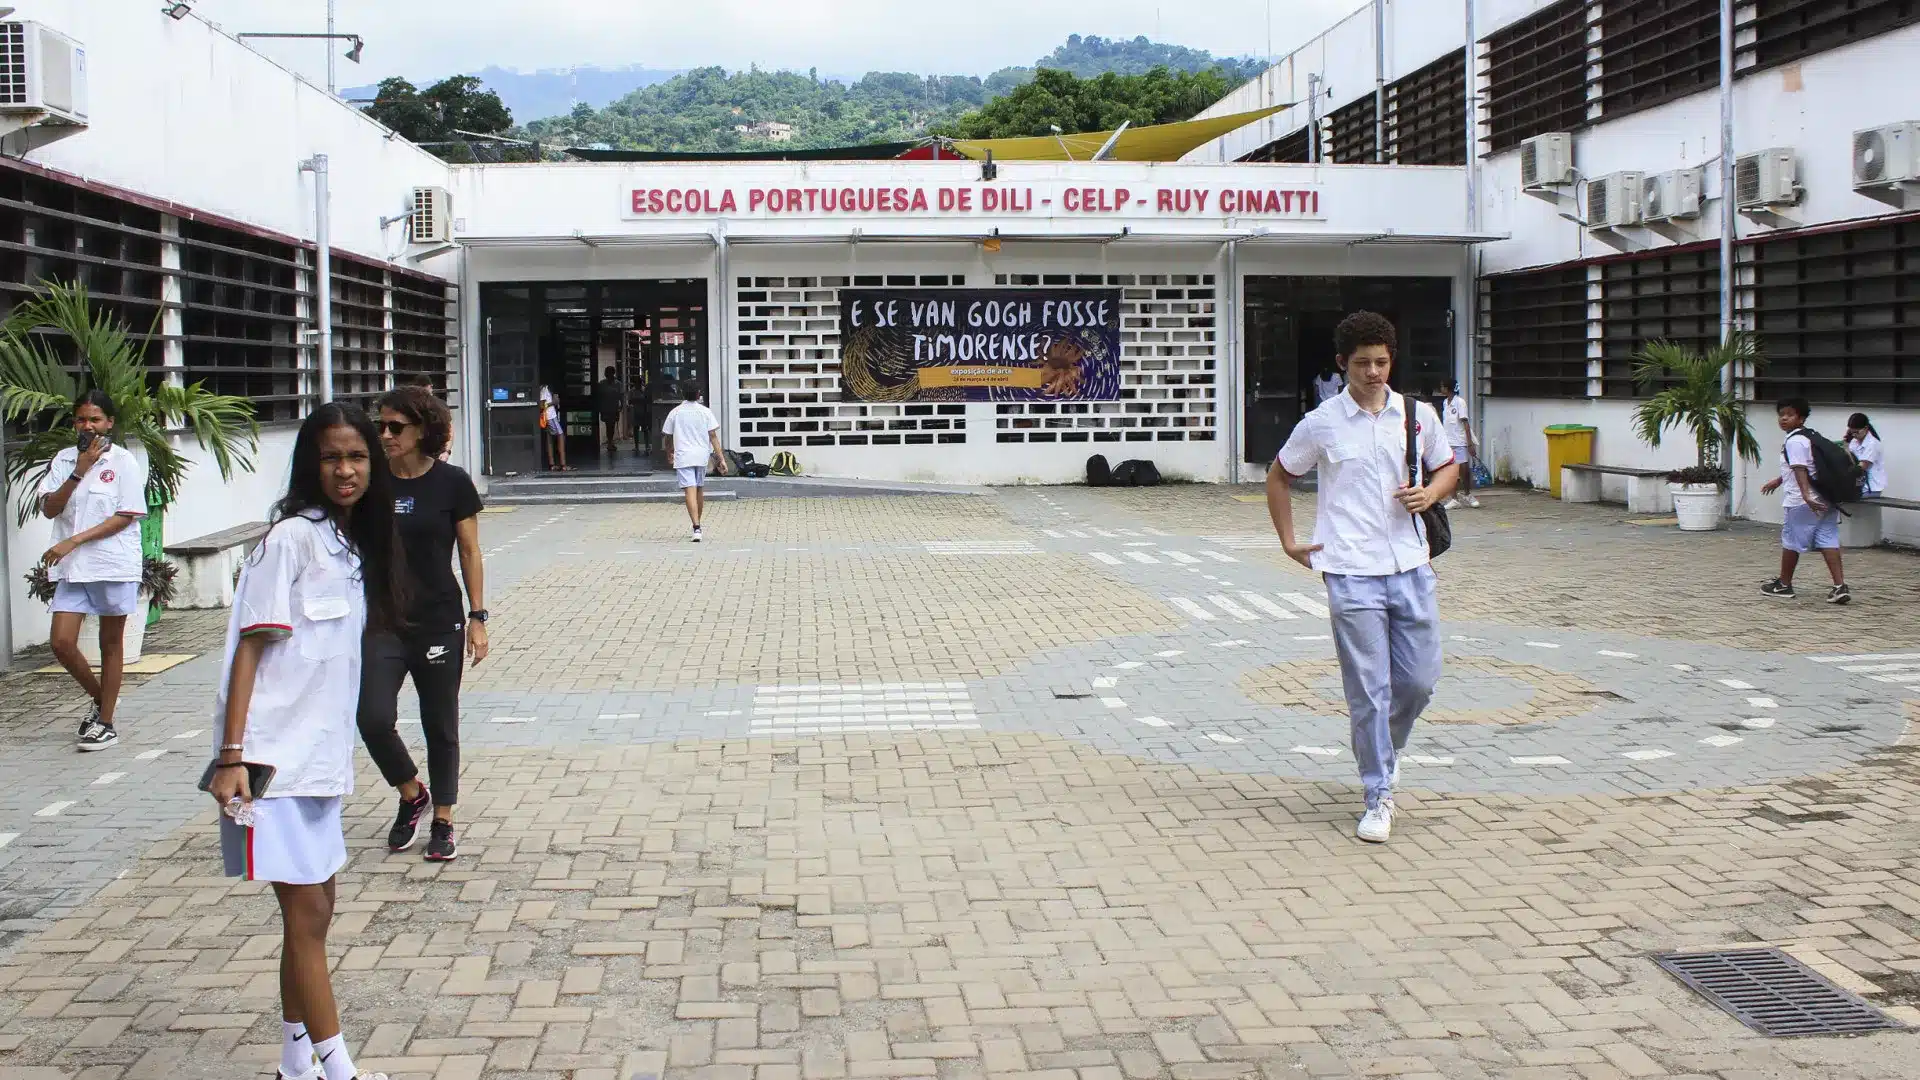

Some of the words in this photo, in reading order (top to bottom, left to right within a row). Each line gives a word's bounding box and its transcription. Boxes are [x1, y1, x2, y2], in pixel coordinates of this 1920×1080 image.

[631, 189, 736, 212] ESCOLA
[749, 188, 928, 211] PORTUGUESA
[939, 188, 971, 210] DE
[982, 188, 1032, 211] DILI
[1063, 188, 1130, 211] CELP
[1157, 189, 1208, 211] RUY
[1219, 190, 1318, 212] CINATTI
[851, 300, 863, 327] E
[875, 300, 899, 327] SE
[910, 300, 955, 328] VAN
[967, 300, 1031, 327] GOGH
[1042, 299, 1109, 327] FOSSE
[429, 646, 445, 654] NIKE
